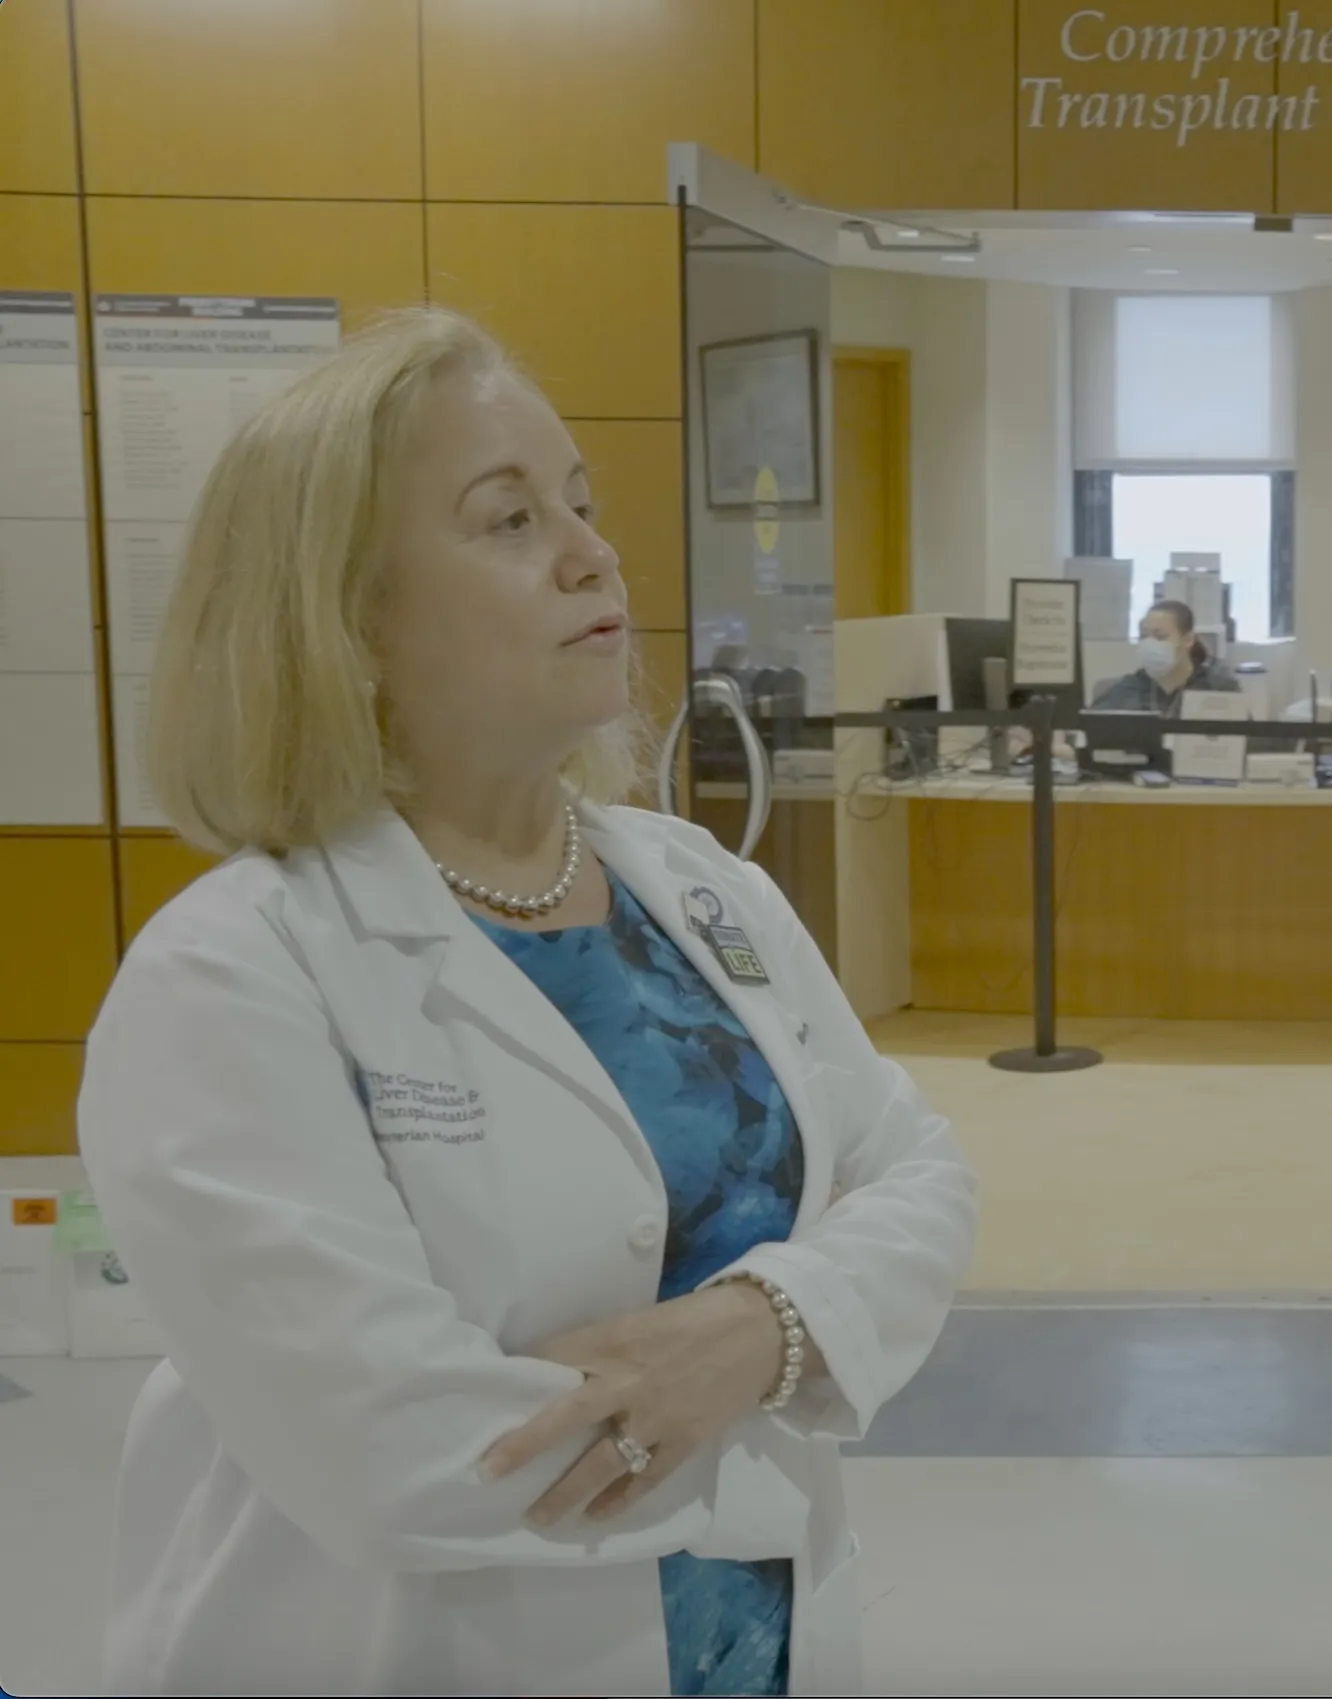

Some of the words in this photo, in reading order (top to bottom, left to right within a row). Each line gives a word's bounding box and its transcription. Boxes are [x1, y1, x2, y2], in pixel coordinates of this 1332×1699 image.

[1020, 76, 1319, 147] Transplant
[105, 342, 133, 353] AND
[726, 951, 763, 974] LIFE
[438, 1081, 458, 1094] for
